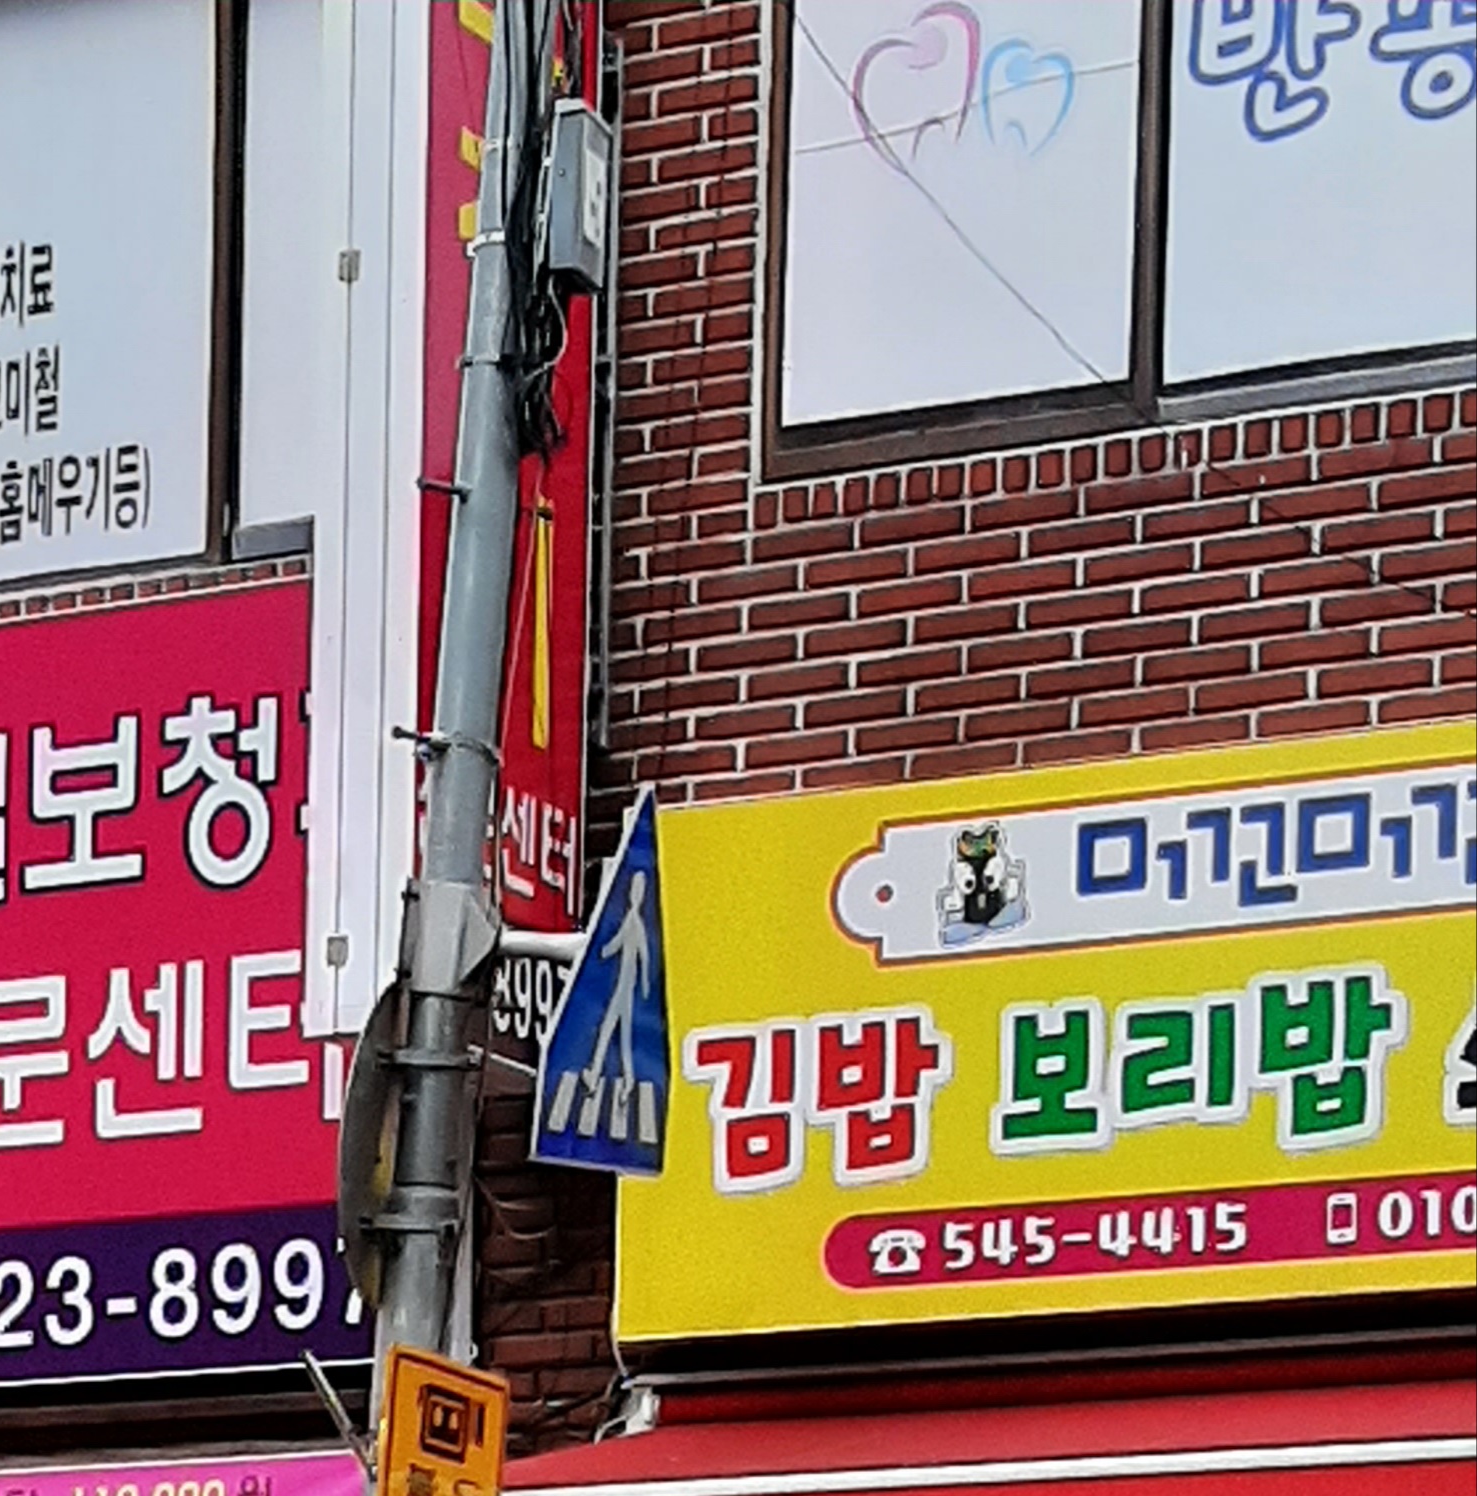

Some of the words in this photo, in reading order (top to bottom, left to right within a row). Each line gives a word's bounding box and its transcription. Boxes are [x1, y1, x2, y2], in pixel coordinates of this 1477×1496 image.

[696, 1016, 940, 1180] 김밥
[1001, 975, 1392, 1142] 보리밥
[941, 1200, 1249, 1270] 545-4415
